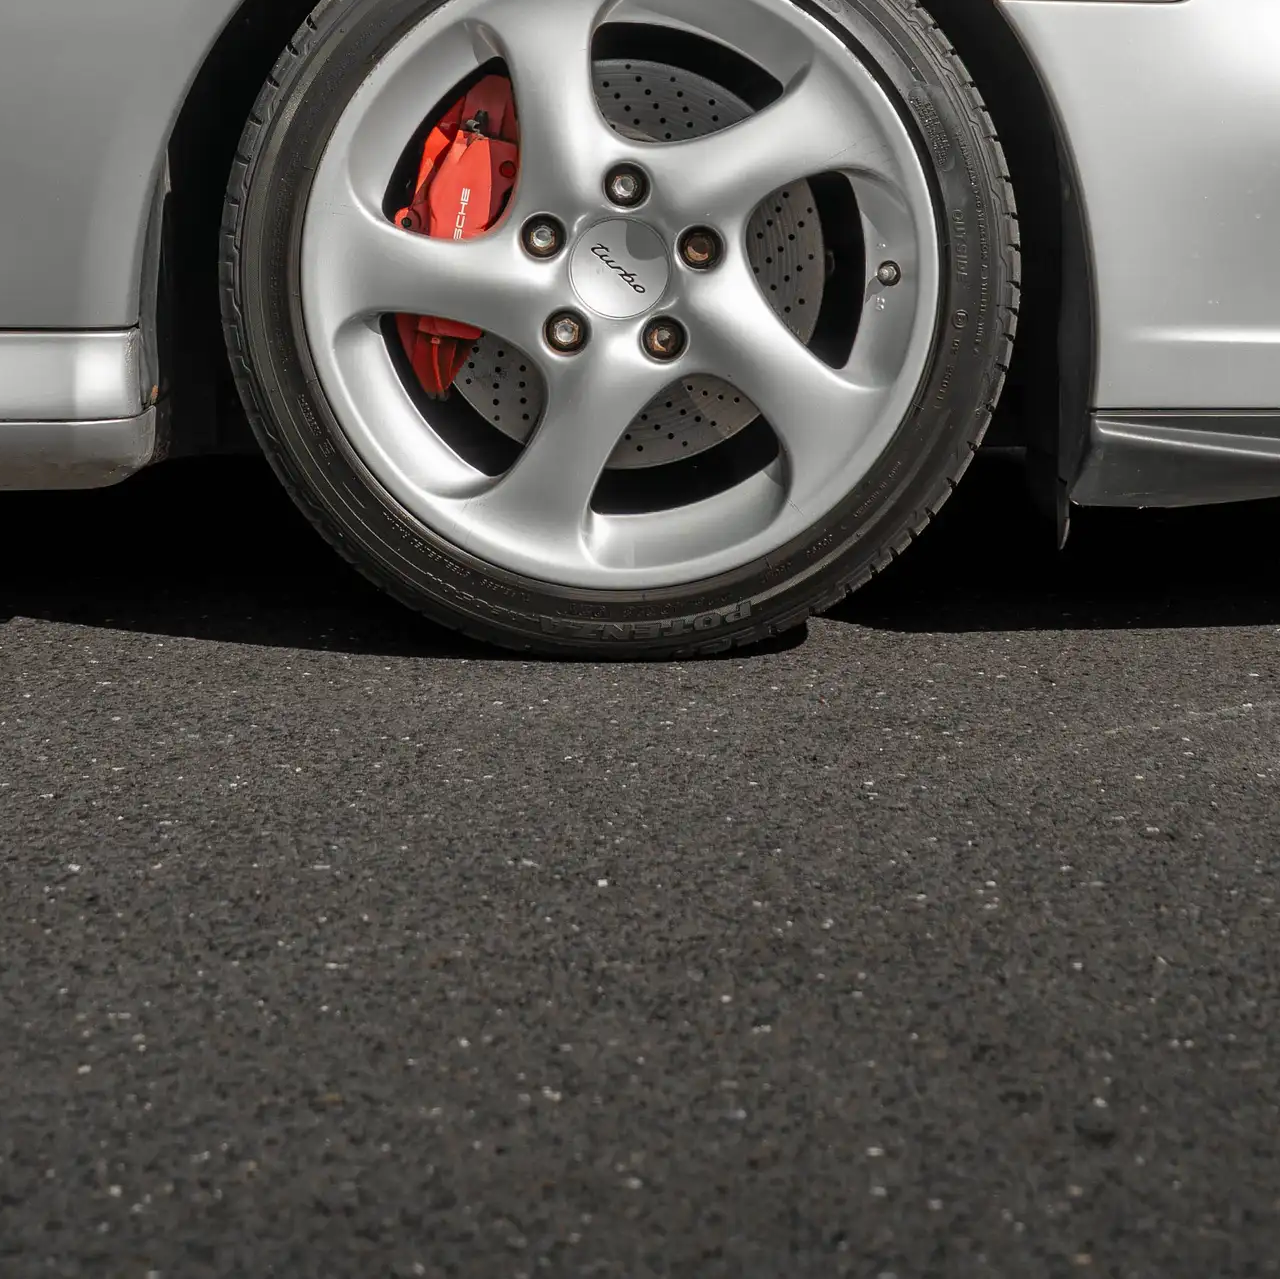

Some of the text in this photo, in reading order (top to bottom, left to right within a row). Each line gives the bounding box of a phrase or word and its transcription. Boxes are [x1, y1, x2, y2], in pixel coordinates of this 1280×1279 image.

[453, 188, 471, 240] SCHE
[590, 243, 646, 294] turbo
[535, 599, 756, 640] POTENZA
